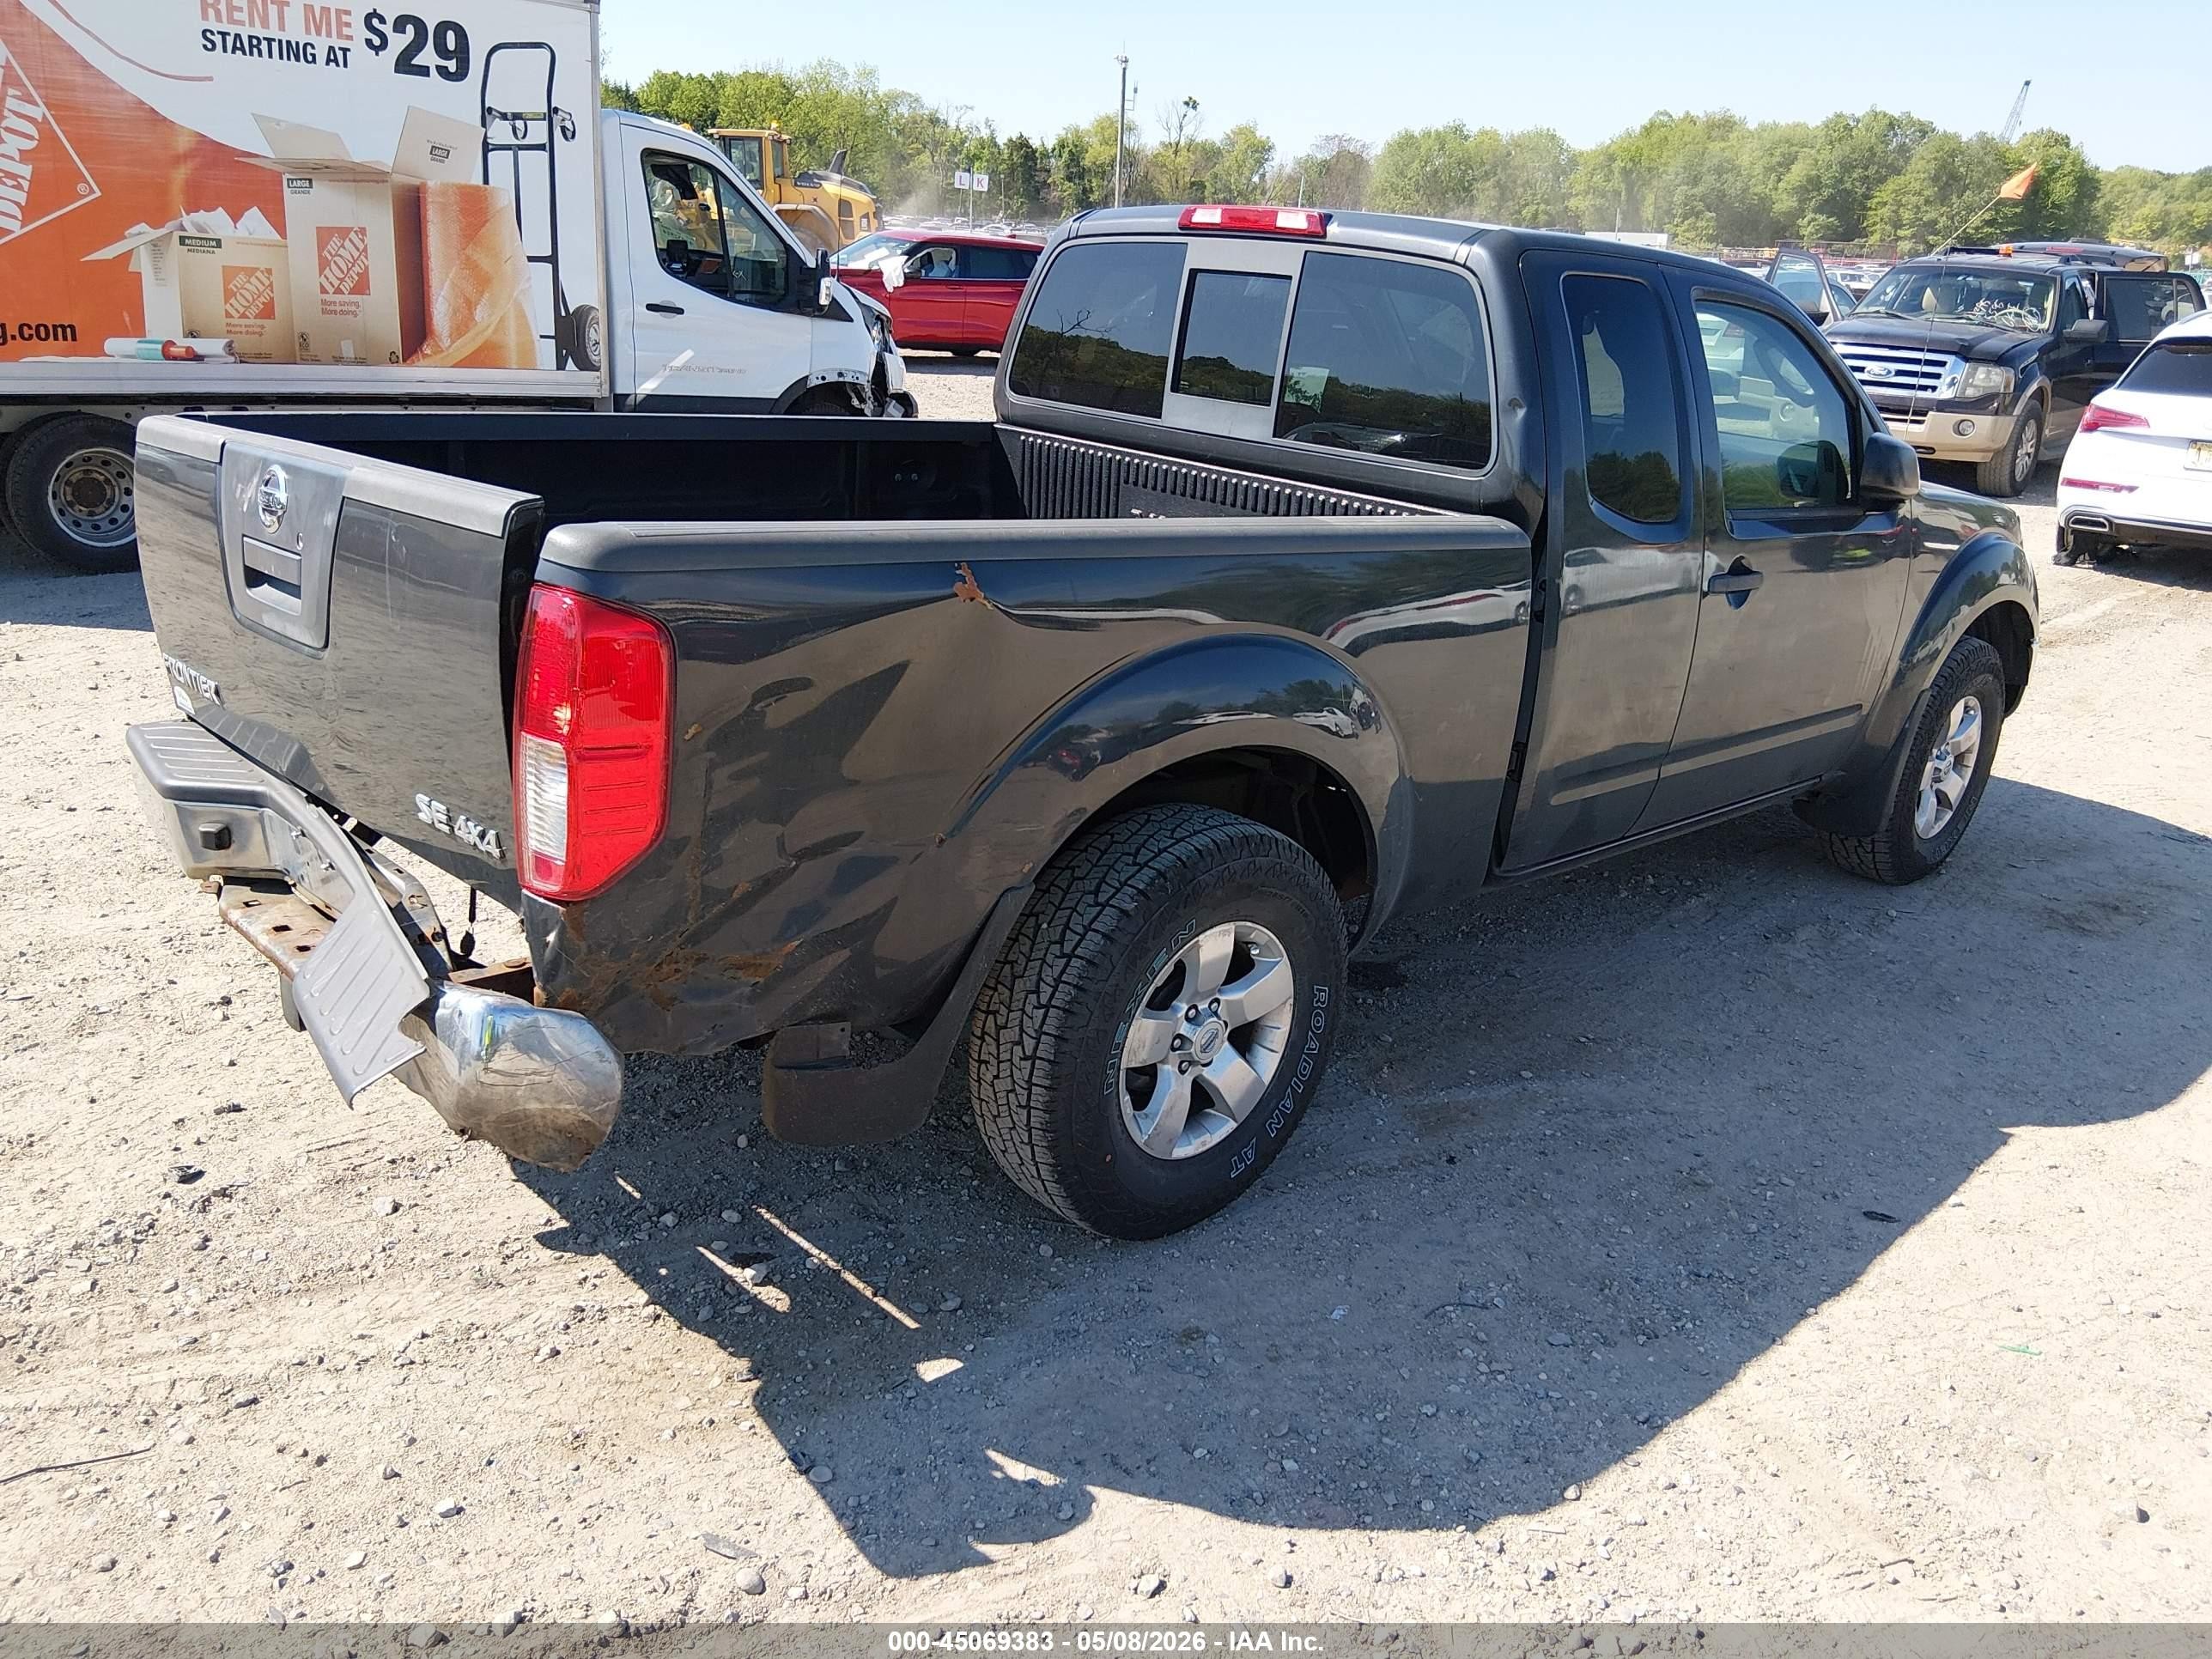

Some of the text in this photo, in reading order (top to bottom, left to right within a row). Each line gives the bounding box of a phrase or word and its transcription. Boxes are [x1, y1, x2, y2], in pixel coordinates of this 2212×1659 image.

[199, 0, 354, 41] RENT ME
[201, 28, 351, 69] STARTING AT
[363, 8, 471, 82] $29
[959, 175, 966, 186] L
[976, 177, 984, 188] K
[184, 239, 218, 247] MEDIUM
[319, 227, 368, 295] HOME
[322, 233, 343, 260] THE
[225, 268, 273, 318] HOME
[227, 272, 249, 292] THE
[339, 252, 368, 295] DEPOT
[245, 287, 274, 319] DEPOT
[320, 298, 337, 307] More
[321, 307, 337, 316] More
[161, 653, 222, 707] FRONTIER
[416, 793, 501, 860] SE 4X4
[1104, 919, 1196, 1095] NEXEN
[1231, 986, 1328, 1178] ROADIAN AT
